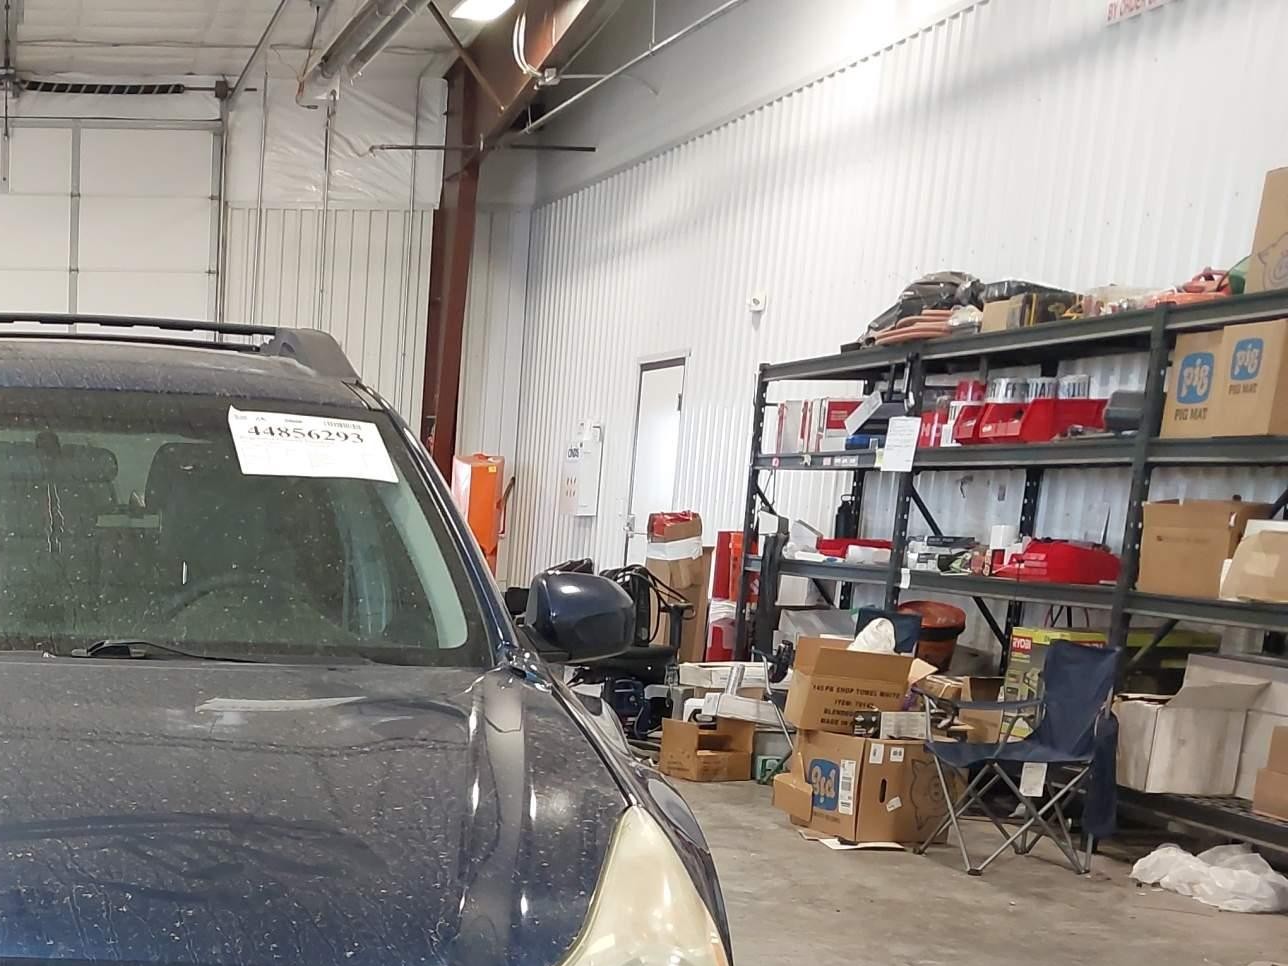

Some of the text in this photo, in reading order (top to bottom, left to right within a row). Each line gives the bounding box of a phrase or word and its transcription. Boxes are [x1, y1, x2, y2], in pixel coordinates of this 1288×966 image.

[1174, 407, 1209, 421] PIG MAT
[248, 425, 365, 444] 44856293
[1012, 637, 1032, 649] RYOBI
[836, 686, 854, 695] SHOP
[855, 688, 877, 697] TOWEL
[880, 690, 901, 700] WHITE
